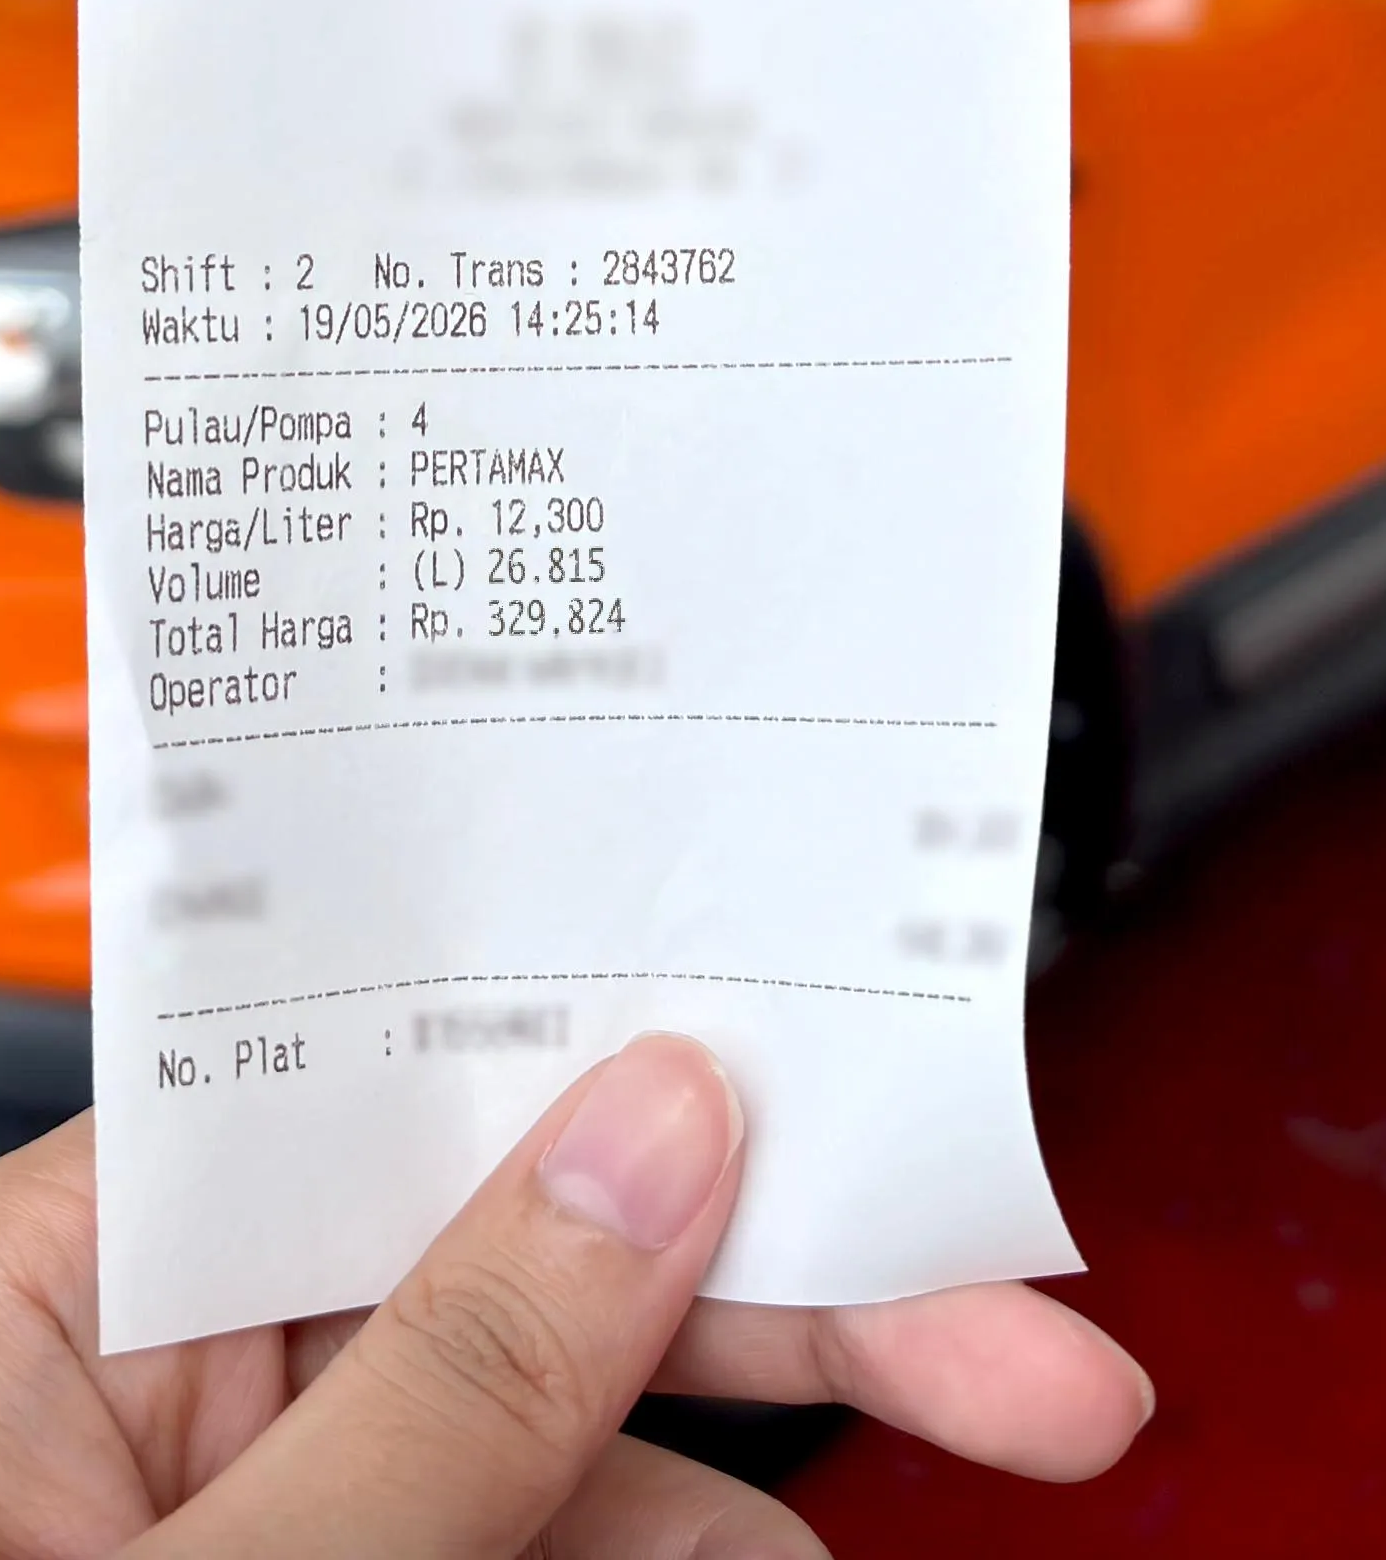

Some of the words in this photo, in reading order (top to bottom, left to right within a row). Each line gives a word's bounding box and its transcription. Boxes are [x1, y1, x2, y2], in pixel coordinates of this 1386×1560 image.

[141, 253, 236, 294] Shift
[296, 253, 314, 291] 2
[374, 252, 425, 290] No.
[449, 251, 544, 289] Trans
[602, 247, 736, 286] 2843762
[142, 305, 239, 346] Waktu
[300, 300, 487, 345] 19/05/2026
[510, 298, 660, 338] 14:25:14
[144, 404, 352, 448] Pulau/Pompa
[411, 400, 429, 437] 4
[147, 460, 223, 500] Nama
[242, 453, 353, 495] Produk
[411, 447, 565, 488] PERTAMAX
[146, 507, 353, 554] Harga/Liter
[411, 500, 463, 543] Rp.
[491, 496, 604, 538] 12,300
[148, 561, 261, 605] Volume
[414, 549, 465, 593] (L)
[148, 611, 238, 659] Total
[261, 610, 353, 651] Harga
[411, 601, 463, 644] Rp.
[149, 665, 298, 717] Operator
[158, 1048, 211, 1090] No.
[235, 1032, 307, 1080] Plat
